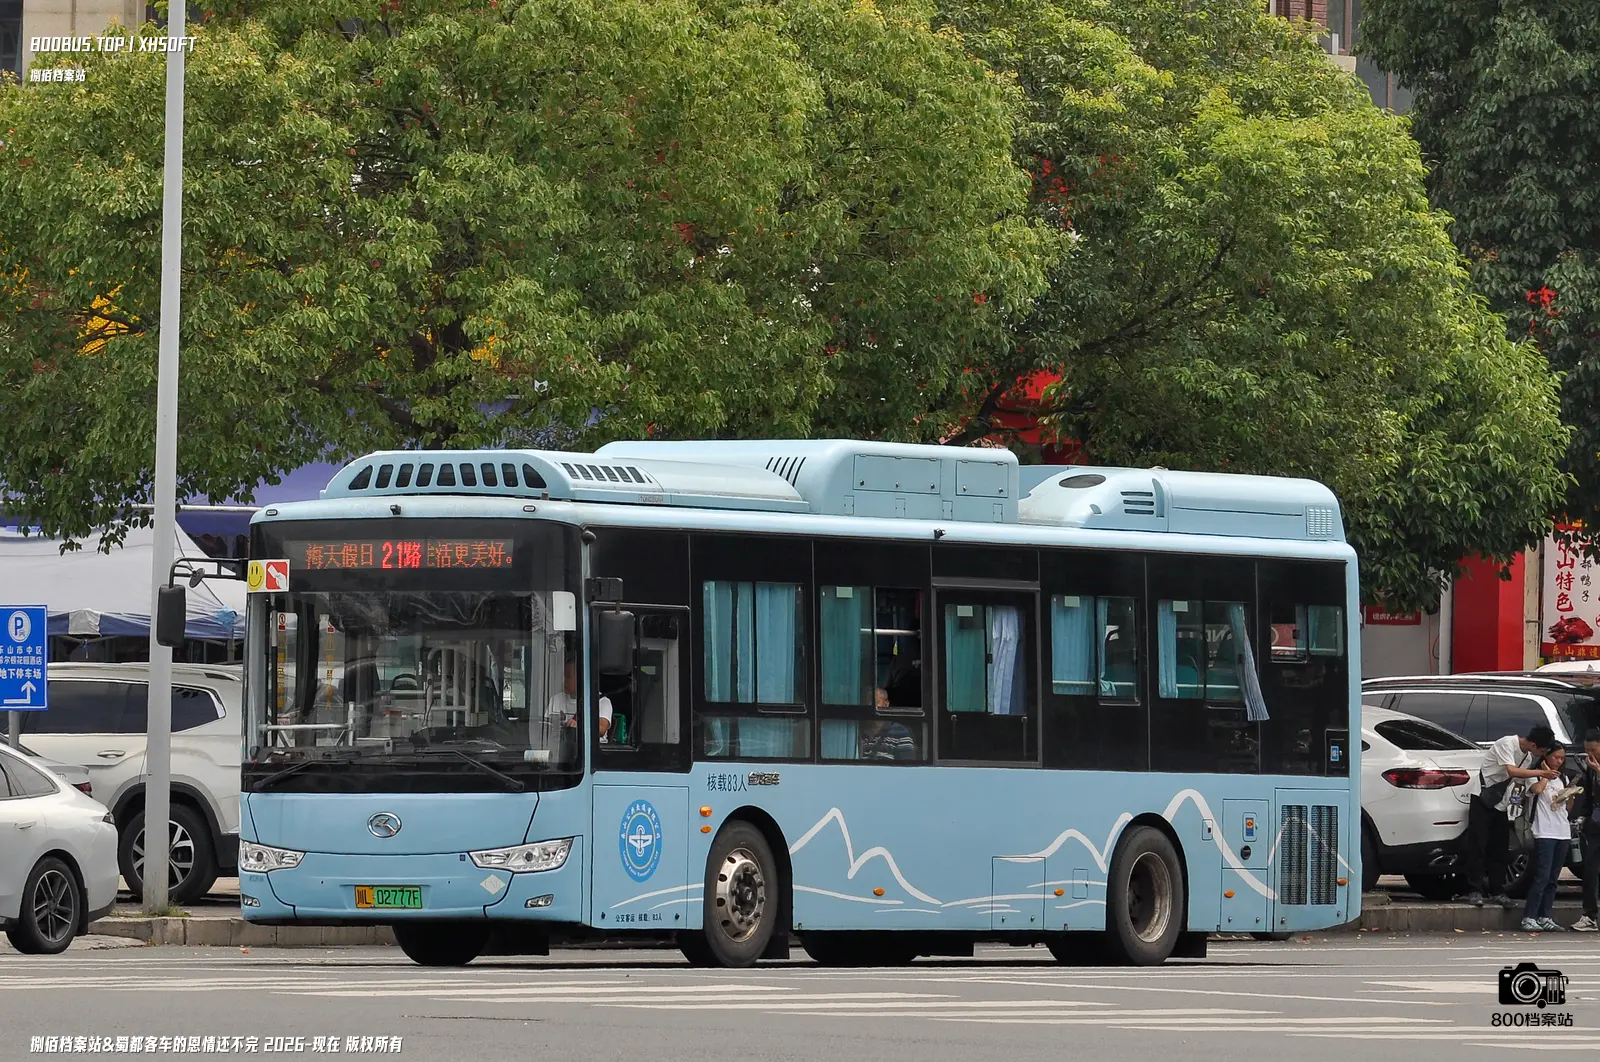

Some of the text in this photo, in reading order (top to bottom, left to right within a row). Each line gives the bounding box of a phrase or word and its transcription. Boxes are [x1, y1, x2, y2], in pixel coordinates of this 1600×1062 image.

[381, 541, 422, 569] 21路
[0, 668, 41, 680] 地下停车场
[706, 773, 747, 791] 核载83人
